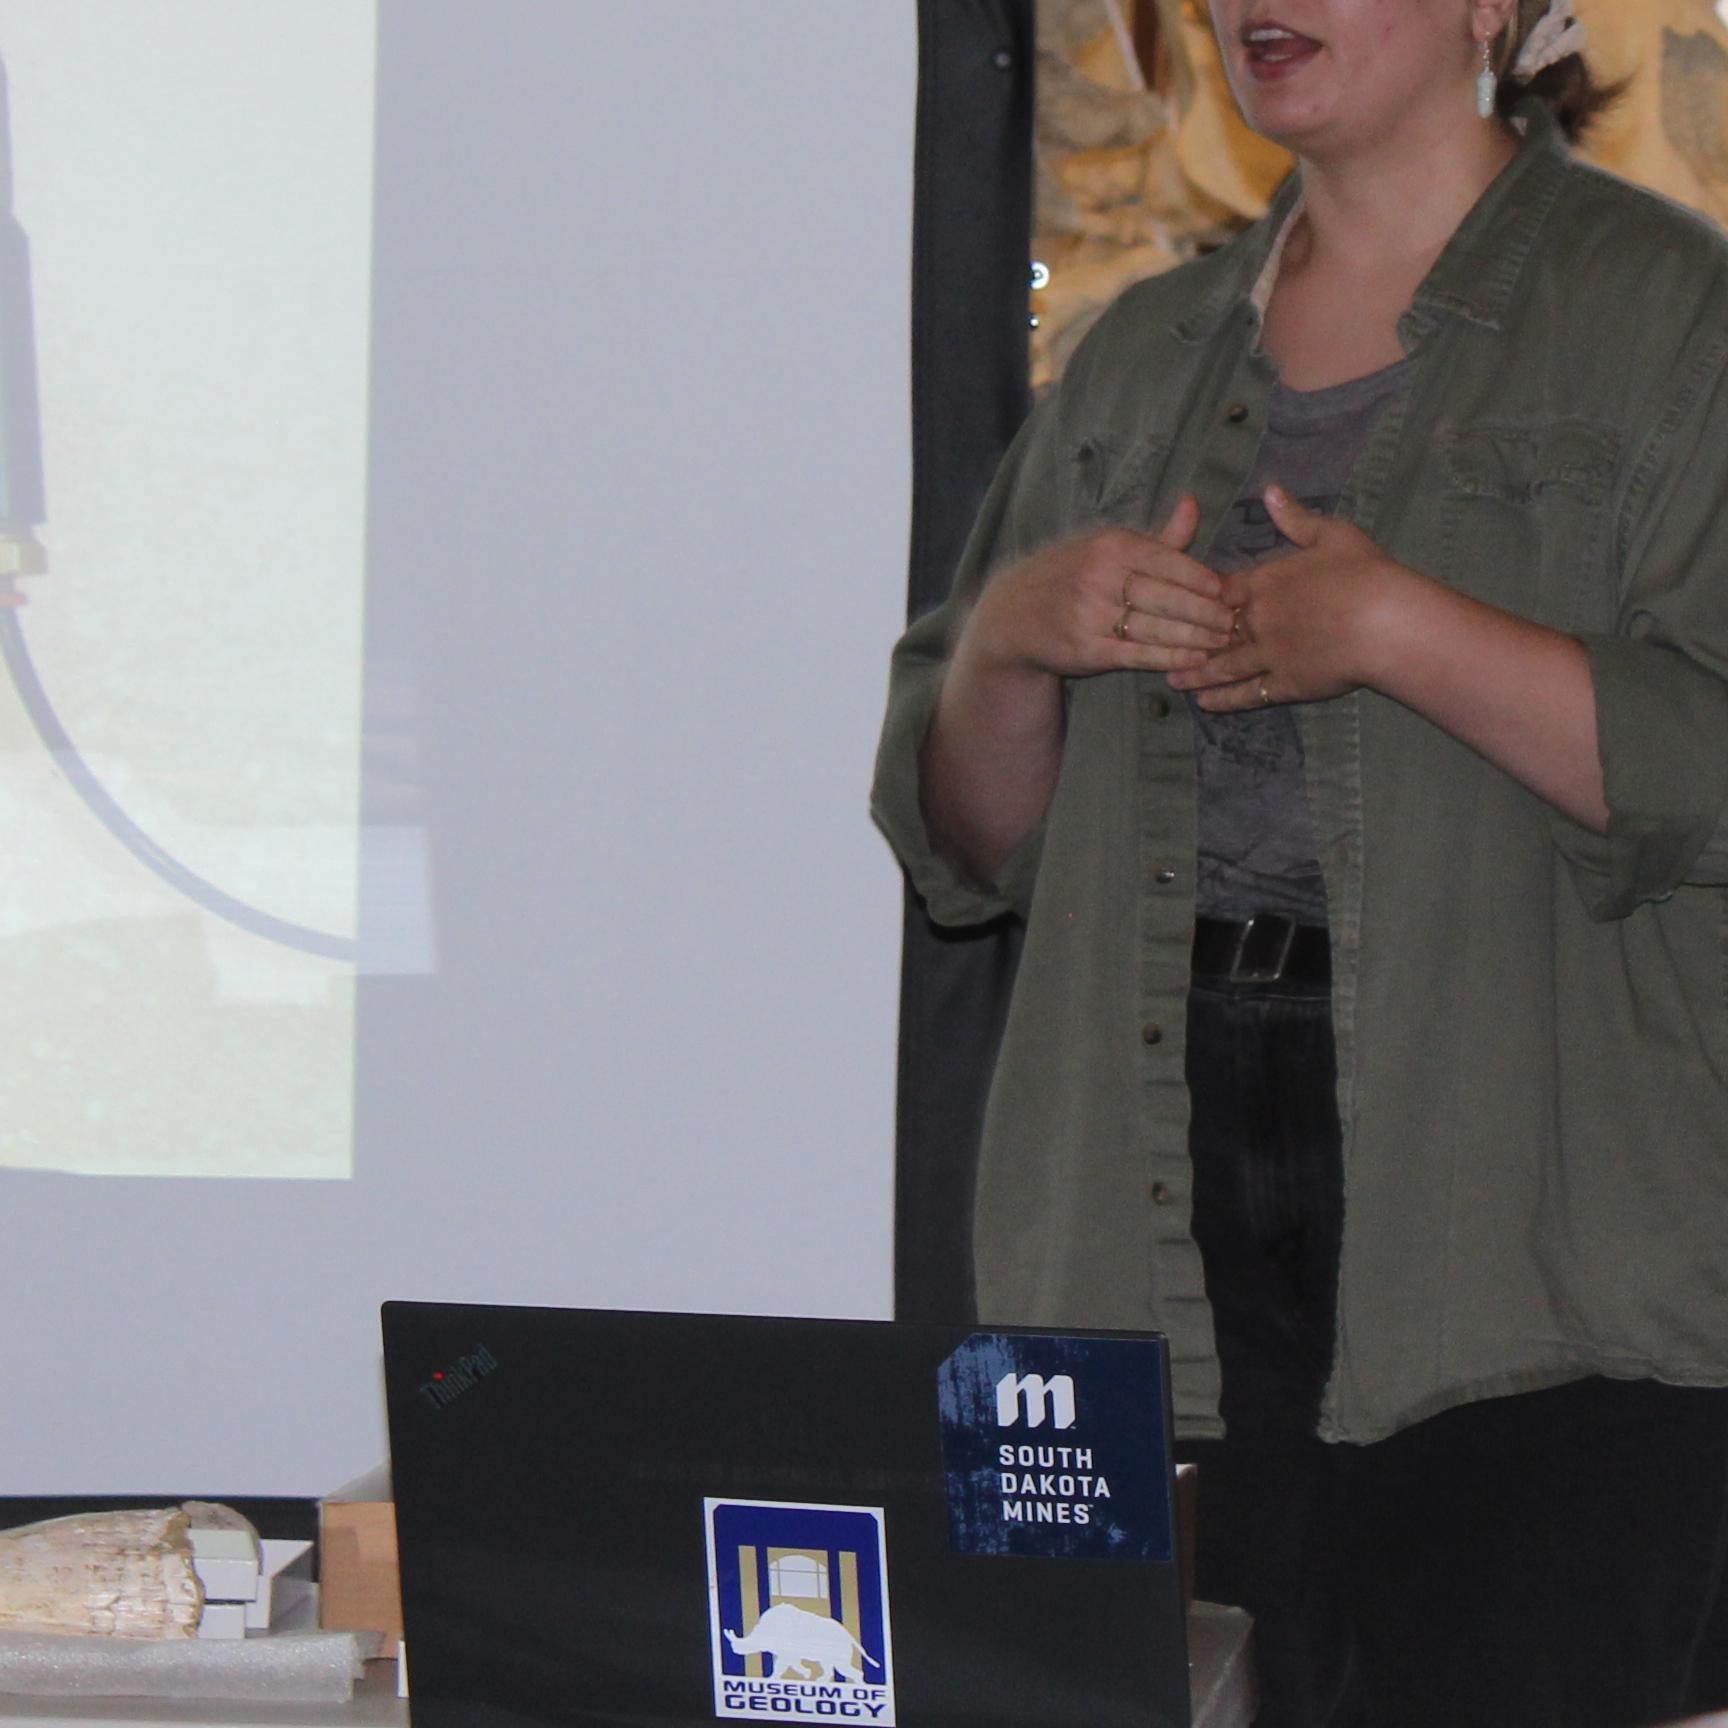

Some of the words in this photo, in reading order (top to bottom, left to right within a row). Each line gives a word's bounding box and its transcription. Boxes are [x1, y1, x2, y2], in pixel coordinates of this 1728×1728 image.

[999, 1444, 1093, 1470] SOUTH
[1001, 1472, 1111, 1498] DAKOTA
[1003, 1500, 1091, 1525] MINES
[723, 1680, 841, 1699] MUSEUM
[852, 1688, 887, 1700] OF
[724, 1694, 888, 1718] GEOLOGY
